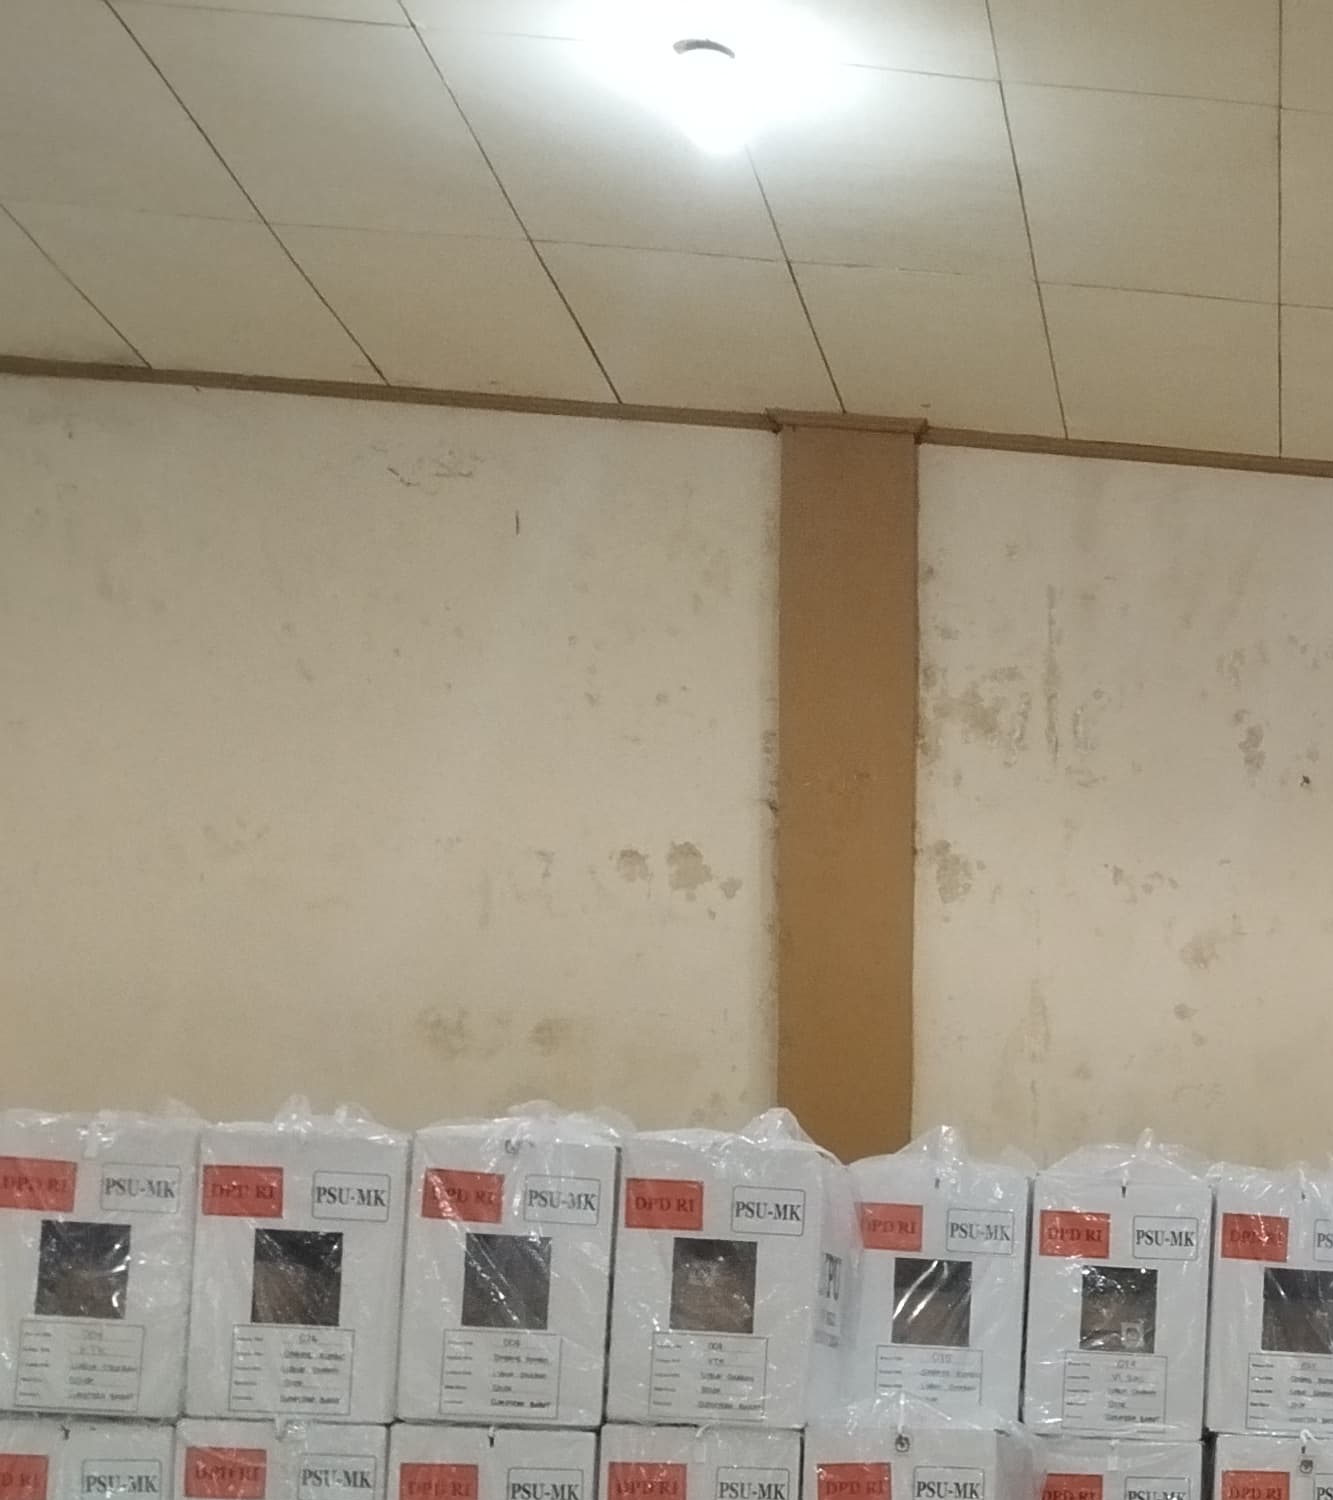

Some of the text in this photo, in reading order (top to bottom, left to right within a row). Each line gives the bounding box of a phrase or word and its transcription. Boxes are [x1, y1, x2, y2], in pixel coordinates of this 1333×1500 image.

[104, 1177, 176, 1199] PSU-MK
[316, 1187, 386, 1208] PSU-MK
[528, 1189, 596, 1211] PSU-MK
[634, 1196, 695, 1213] DPD RI
[735, 1201, 801, 1222] PSU-MK
[899, 1221, 917, 1236] RI
[950, 1222, 1011, 1241] PSU-MK
[1136, 1229, 1195, 1248] PSU-MK
[85, 1474, 159, 1493] PSU-MK
[301, 1469, 372, 1488] PSU-MK
[825, 1480, 885, 1496] DPD RI
[451, 1481, 471, 1497] RI
[659, 1481, 678, 1496] RI
[719, 1481, 786, 1500] PSU-MK
[917, 1480, 981, 1500] PSU-MK
[1230, 1487, 1260, 1500] DPD
